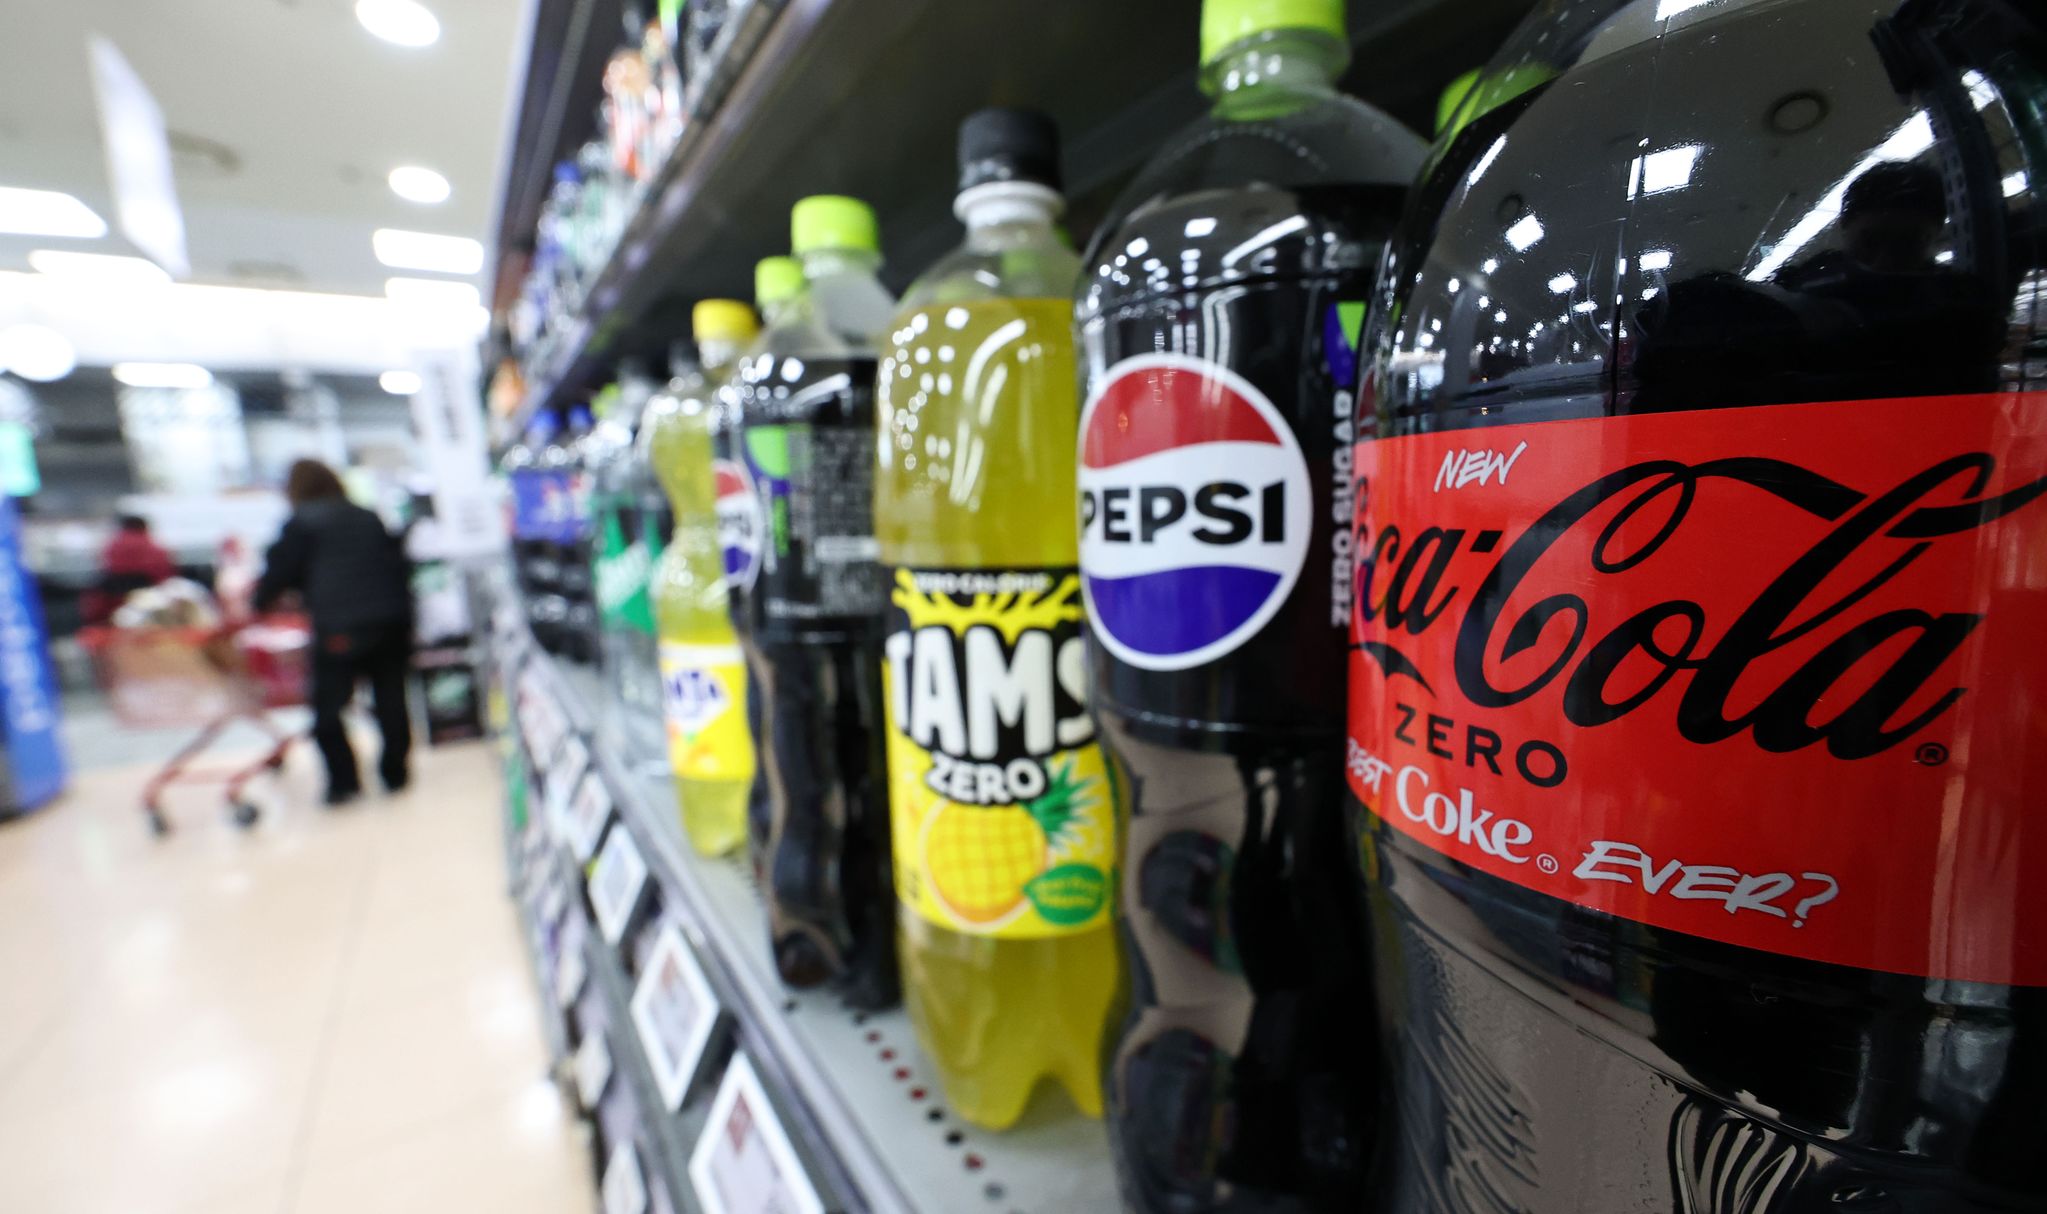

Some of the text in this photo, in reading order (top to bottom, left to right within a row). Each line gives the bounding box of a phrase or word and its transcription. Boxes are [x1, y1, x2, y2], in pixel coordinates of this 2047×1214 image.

[1434, 440, 1528, 494] NEW
[1331, 529, 1353, 627] ZERO
[1358, 450, 2047, 763] ca-Cola
[927, 752, 1046, 805] ZERO
[1394, 702, 1568, 789] ZERO
[1395, 764, 1534, 865] Coke
[1573, 840, 1840, 929] EVER?
